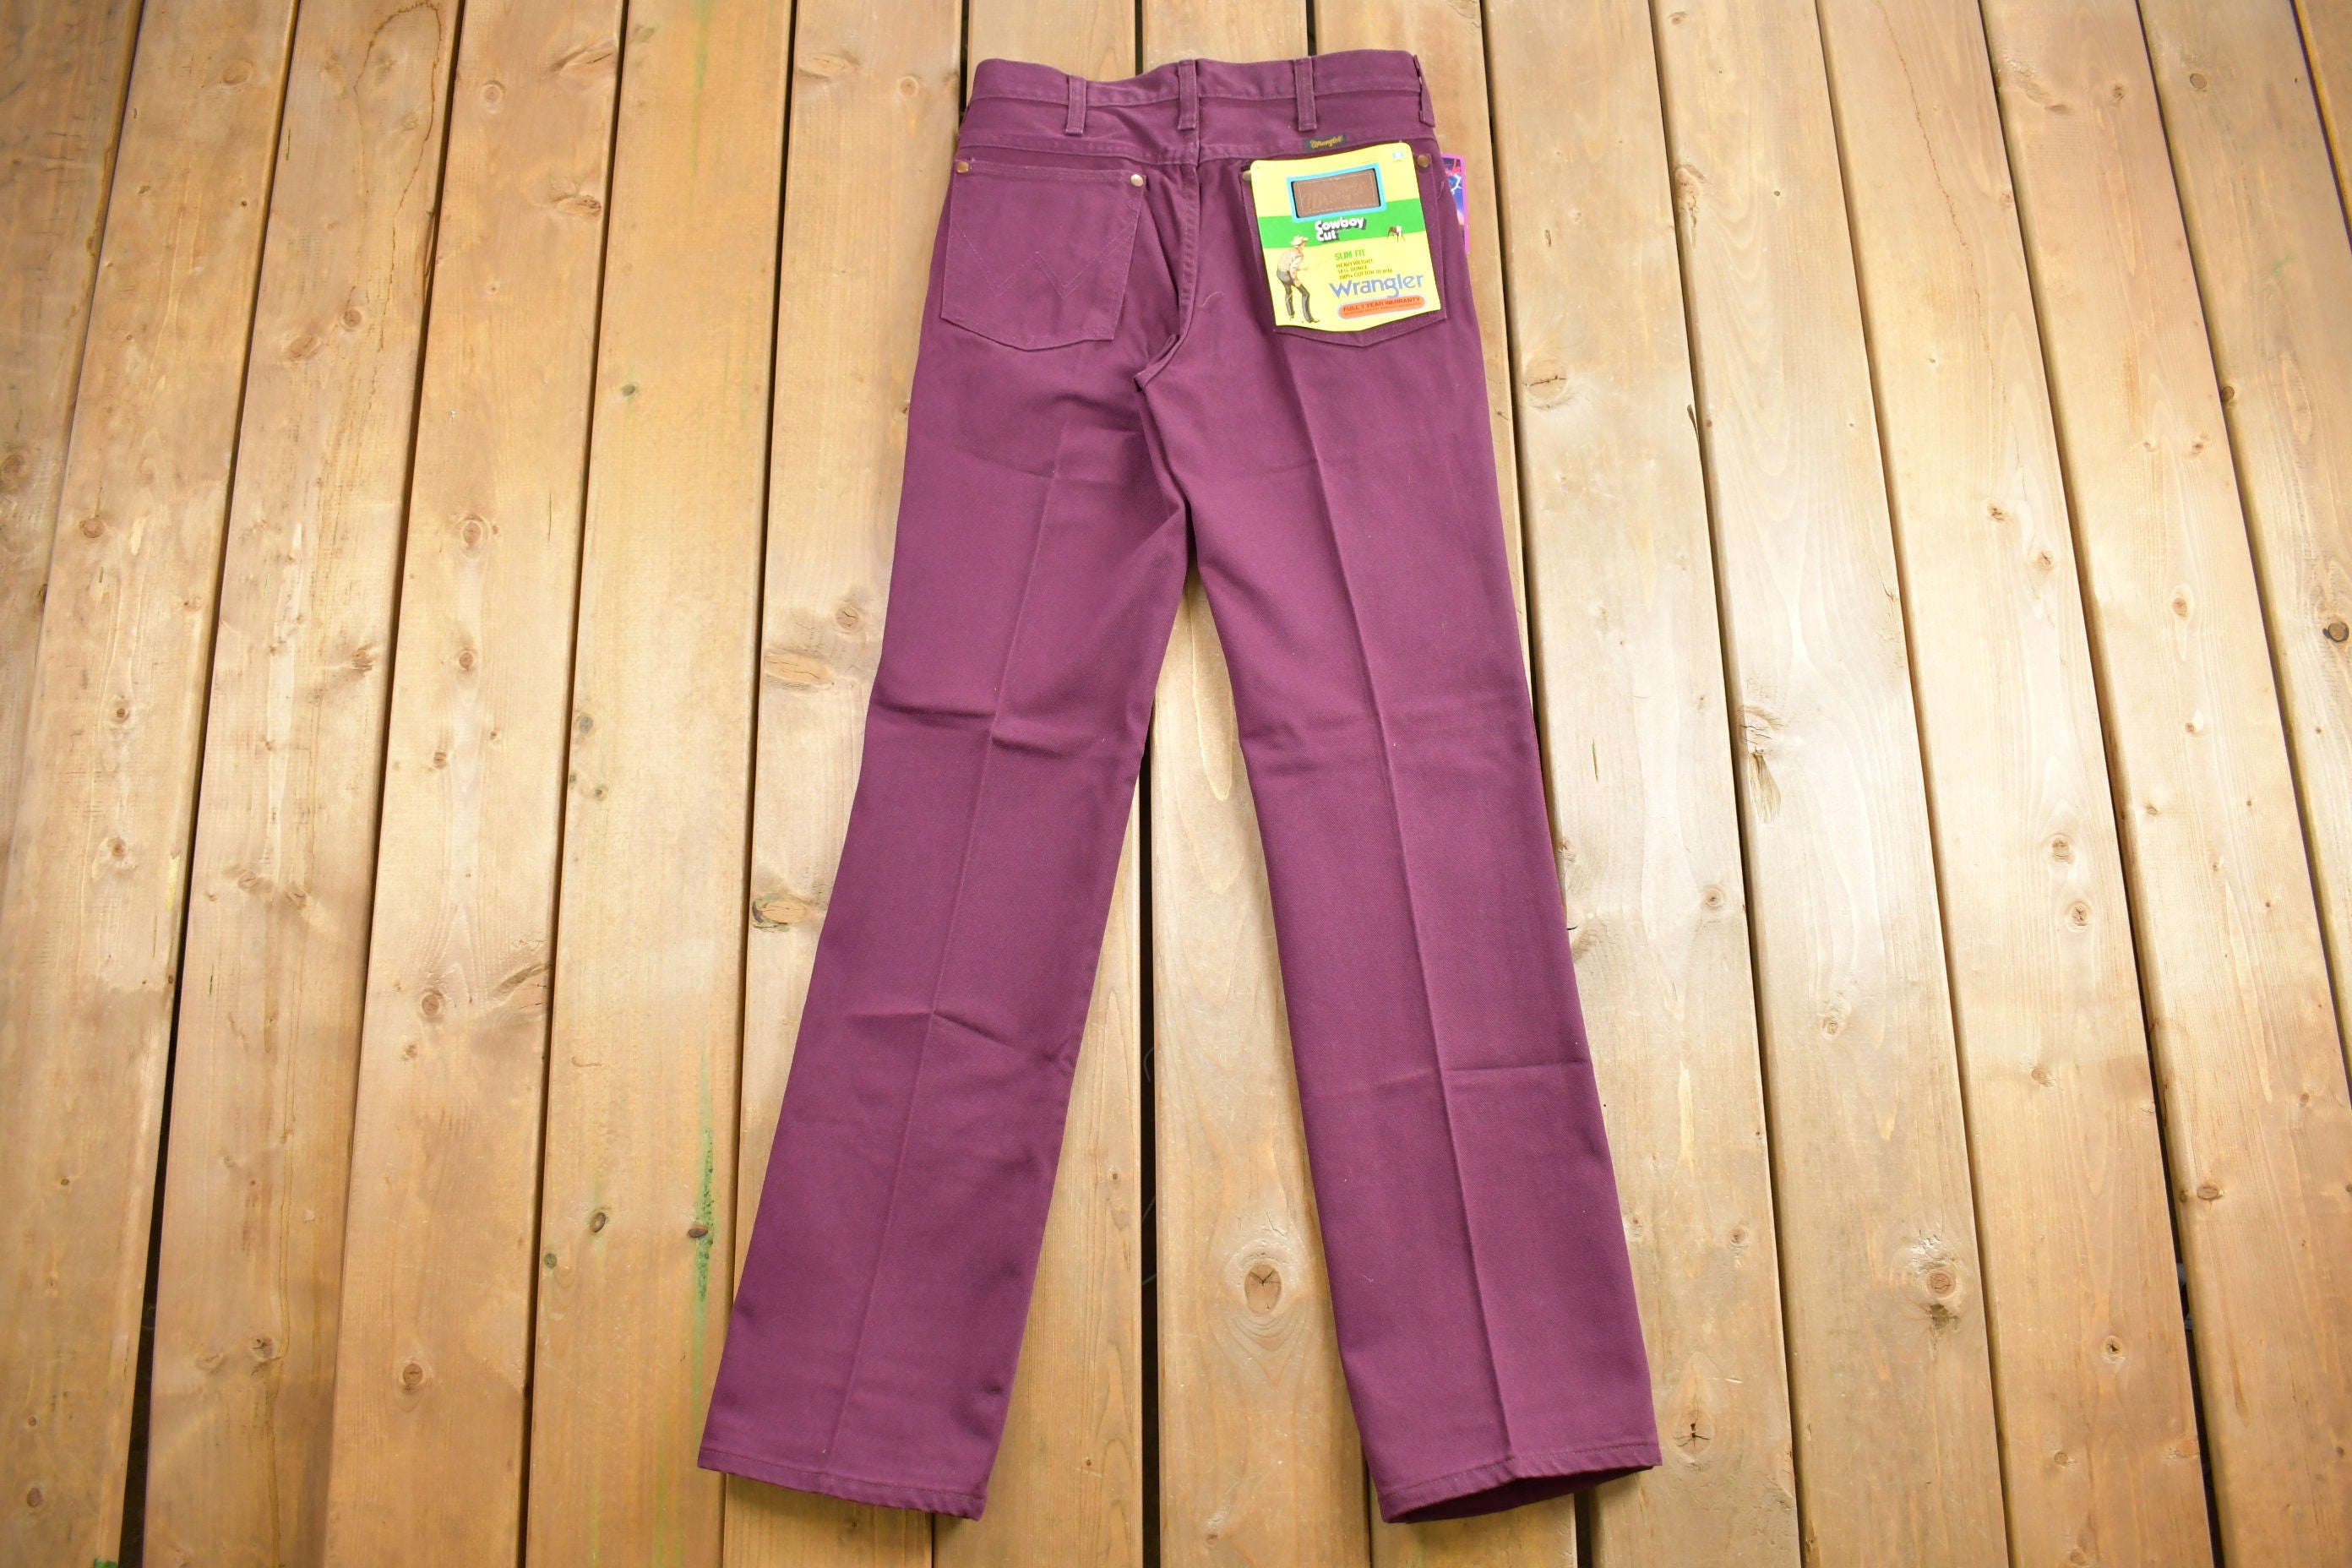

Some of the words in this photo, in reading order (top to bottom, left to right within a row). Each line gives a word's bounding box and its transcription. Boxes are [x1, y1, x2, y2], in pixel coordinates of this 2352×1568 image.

[1315, 217, 1365, 231] Cowboy
[1316, 229, 1338, 242] Cut
[1335, 250, 1353, 261] SLIM
[1355, 248, 1365, 257] FIT
[1336, 258, 1373, 269] HEAVYWEIGHT
[1353, 270, 1375, 278] COTTON
[1329, 274, 1424, 299] Wrangler
[1385, 297, 1420, 306] WARRANTY
